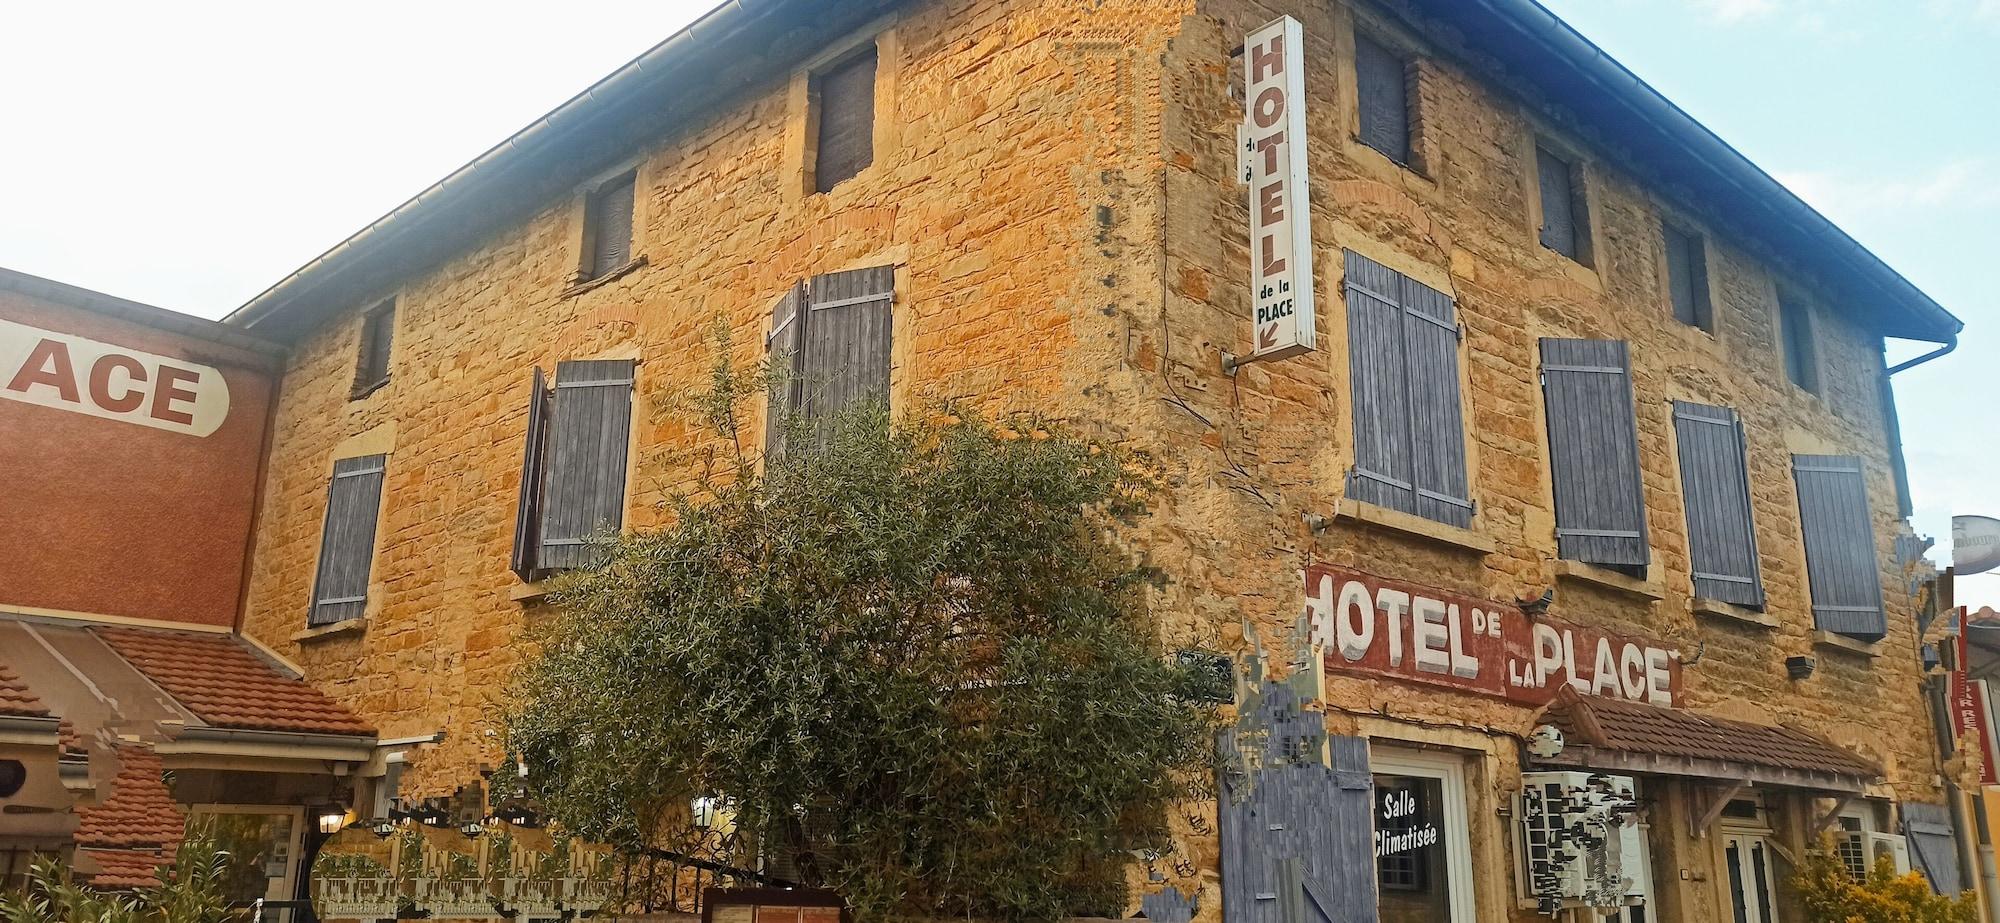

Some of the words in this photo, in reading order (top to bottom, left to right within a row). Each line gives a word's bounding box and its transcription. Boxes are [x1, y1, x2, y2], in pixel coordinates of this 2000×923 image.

[1252, 35, 1286, 278] HOTEL
[1260, 284, 1274, 300] de
[1279, 279, 1289, 294] la
[1258, 298, 1293, 325] PLACE
[7, 337, 200, 426] ACE
[1472, 607, 1502, 639] DE
[1509, 658, 1535, 689] LA
[1533, 622, 1673, 709] PLACE
[1383, 789, 1416, 820] Salle
[1375, 822, 1437, 858] Climatisée
